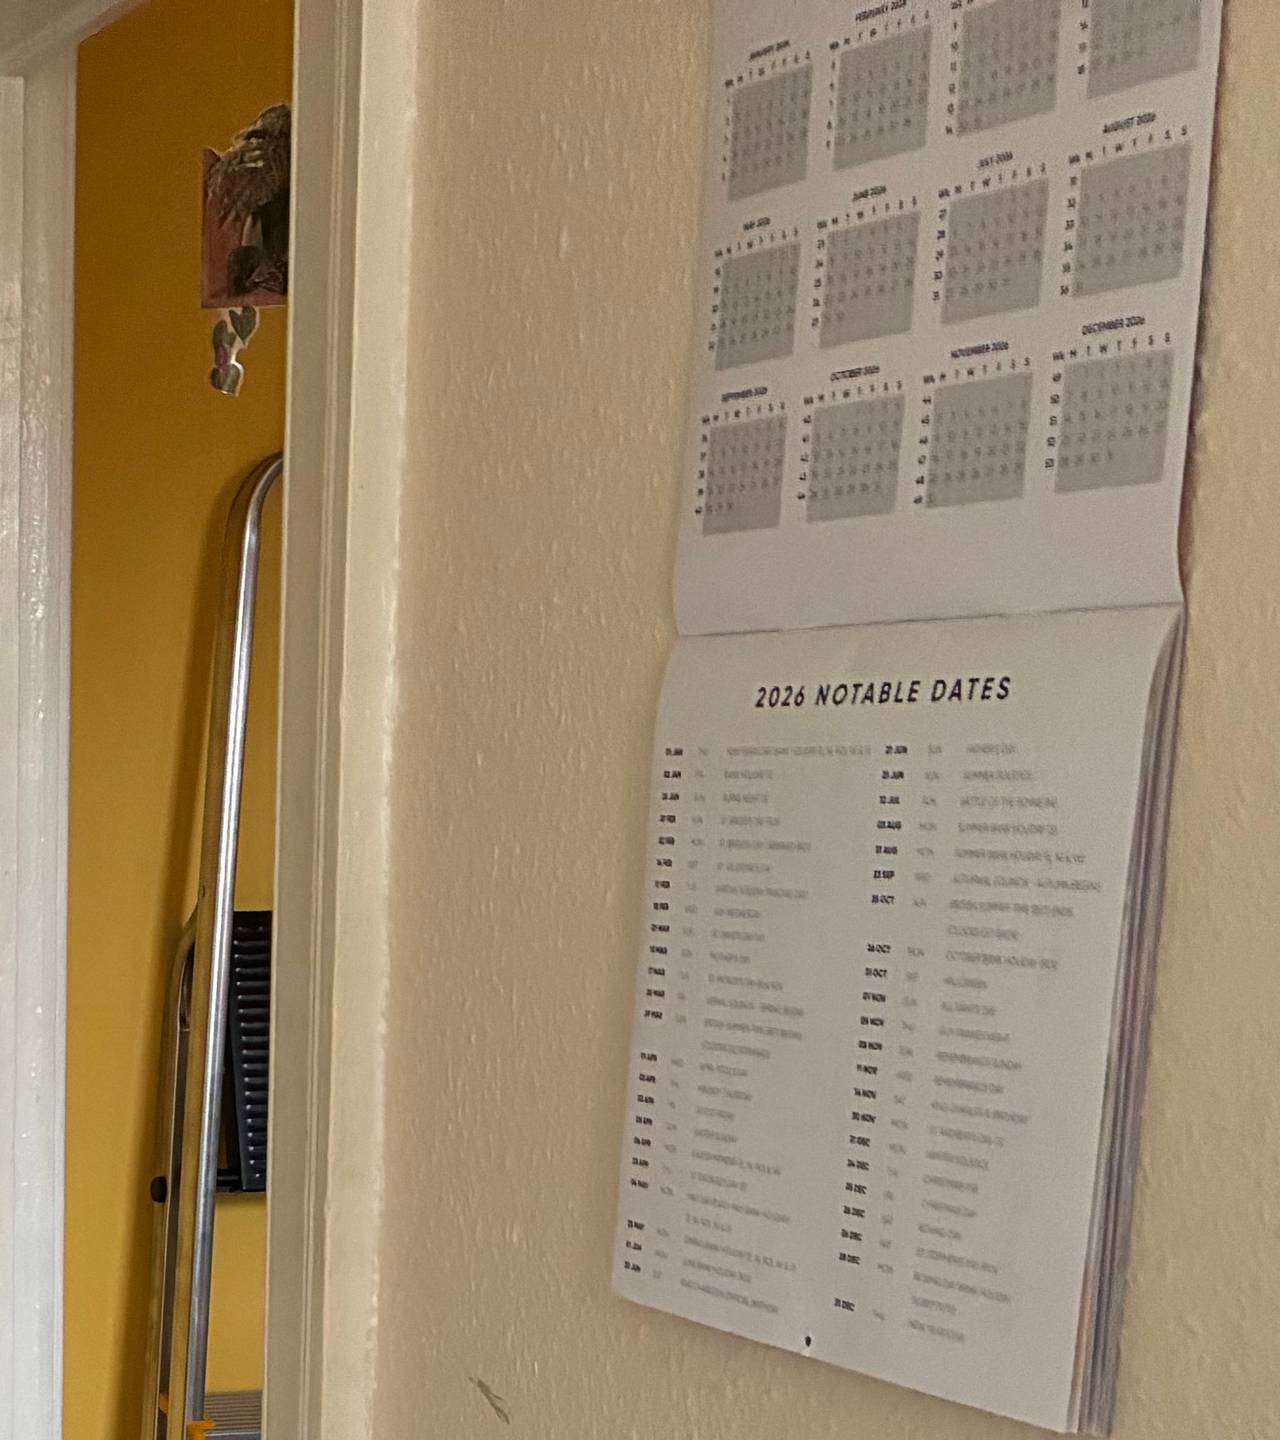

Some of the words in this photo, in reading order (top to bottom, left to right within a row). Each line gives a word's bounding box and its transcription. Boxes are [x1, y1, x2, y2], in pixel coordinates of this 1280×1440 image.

[755, 684, 807, 708] 2026
[814, 679, 921, 707] NOTABLE
[930, 676, 1012, 702] DATES
